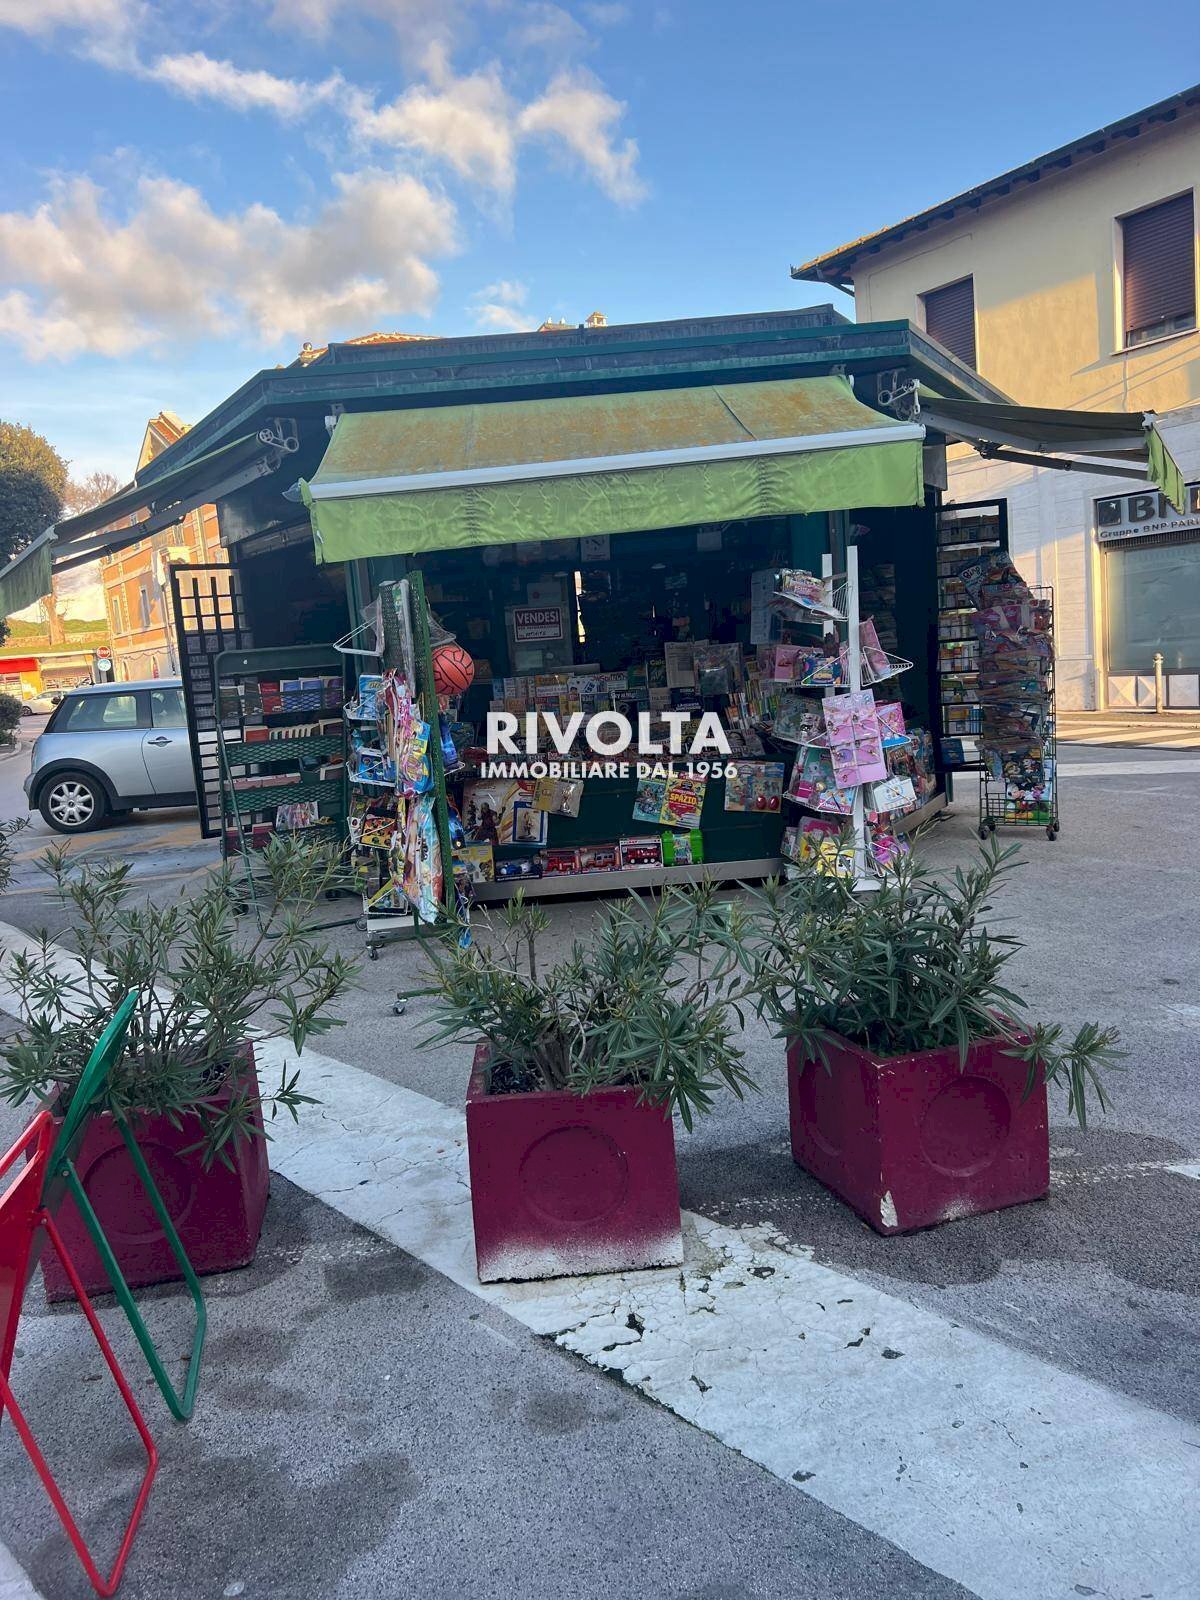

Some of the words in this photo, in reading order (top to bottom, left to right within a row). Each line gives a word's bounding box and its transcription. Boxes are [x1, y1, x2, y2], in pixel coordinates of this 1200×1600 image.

[1143, 522, 1167, 533] BNP
[516, 611, 559, 624] VENDESI
[669, 793, 697, 805] SPAZIO
